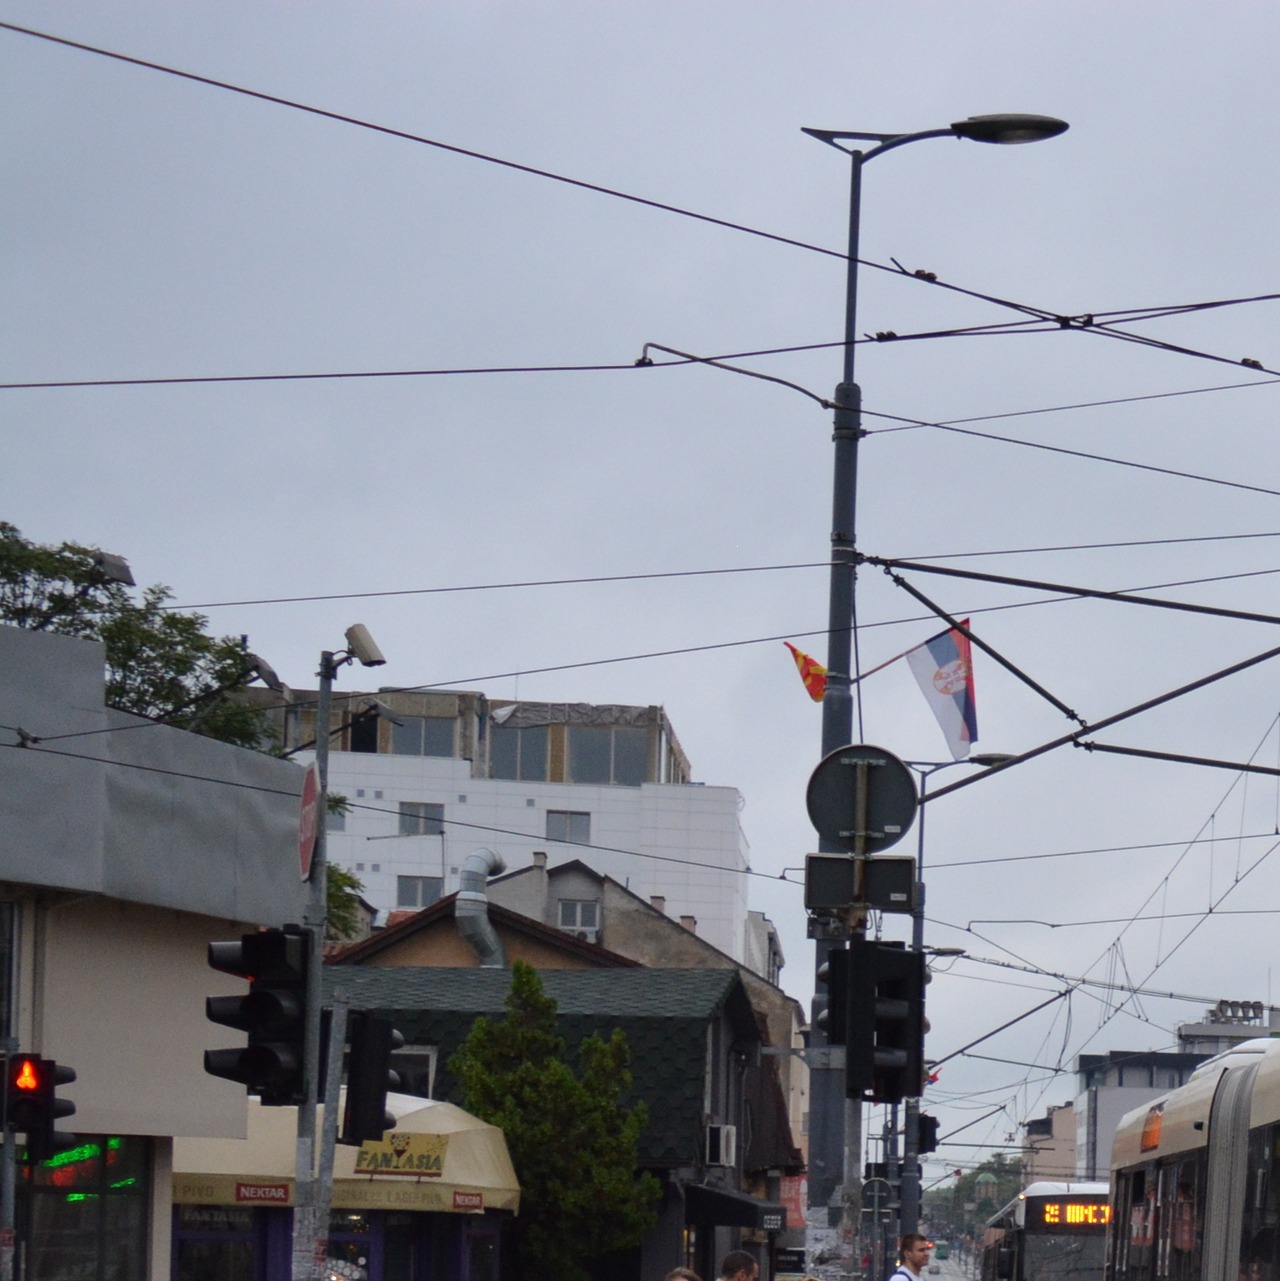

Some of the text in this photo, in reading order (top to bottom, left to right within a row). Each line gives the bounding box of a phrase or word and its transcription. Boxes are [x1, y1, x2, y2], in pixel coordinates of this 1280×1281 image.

[356, 1150, 442, 1171] FANTASIA
[239, 1186, 285, 1199] NEKTAR
[455, 1194, 481, 1206] NEKTAR
